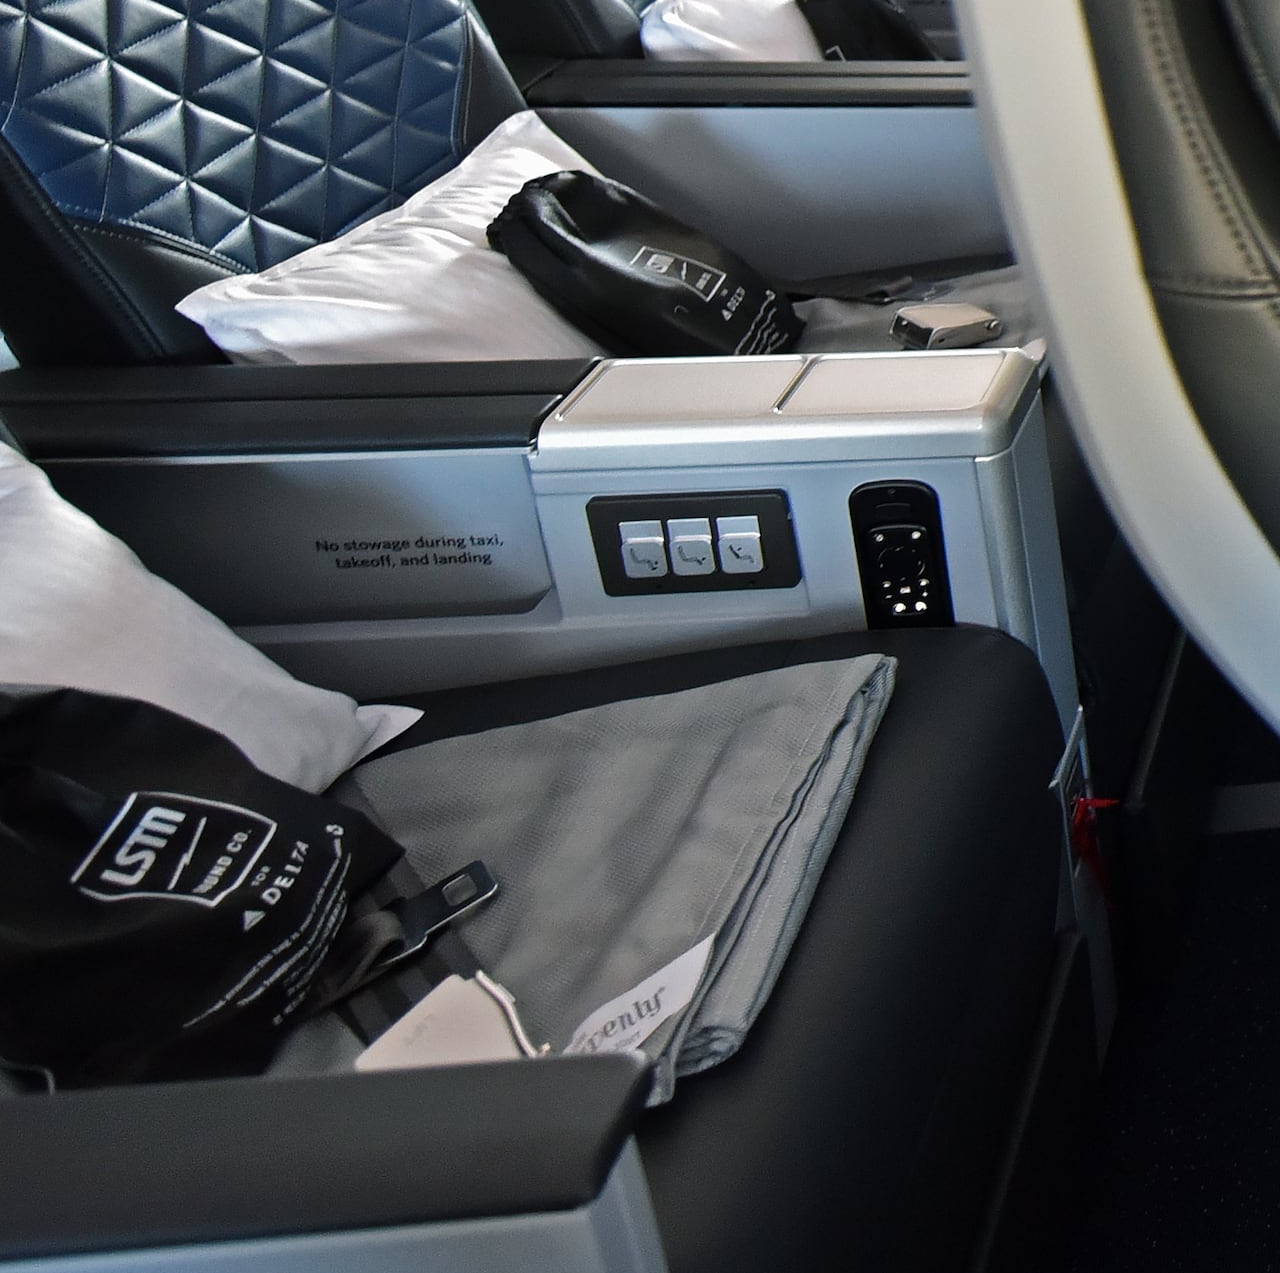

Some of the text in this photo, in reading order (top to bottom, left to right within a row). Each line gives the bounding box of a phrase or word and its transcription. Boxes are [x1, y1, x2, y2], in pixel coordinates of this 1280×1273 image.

[315, 533, 504, 553] No stowage during taxi,
[335, 551, 493, 570] takeoff, and landing
[261, 840, 309, 906] DELTA
